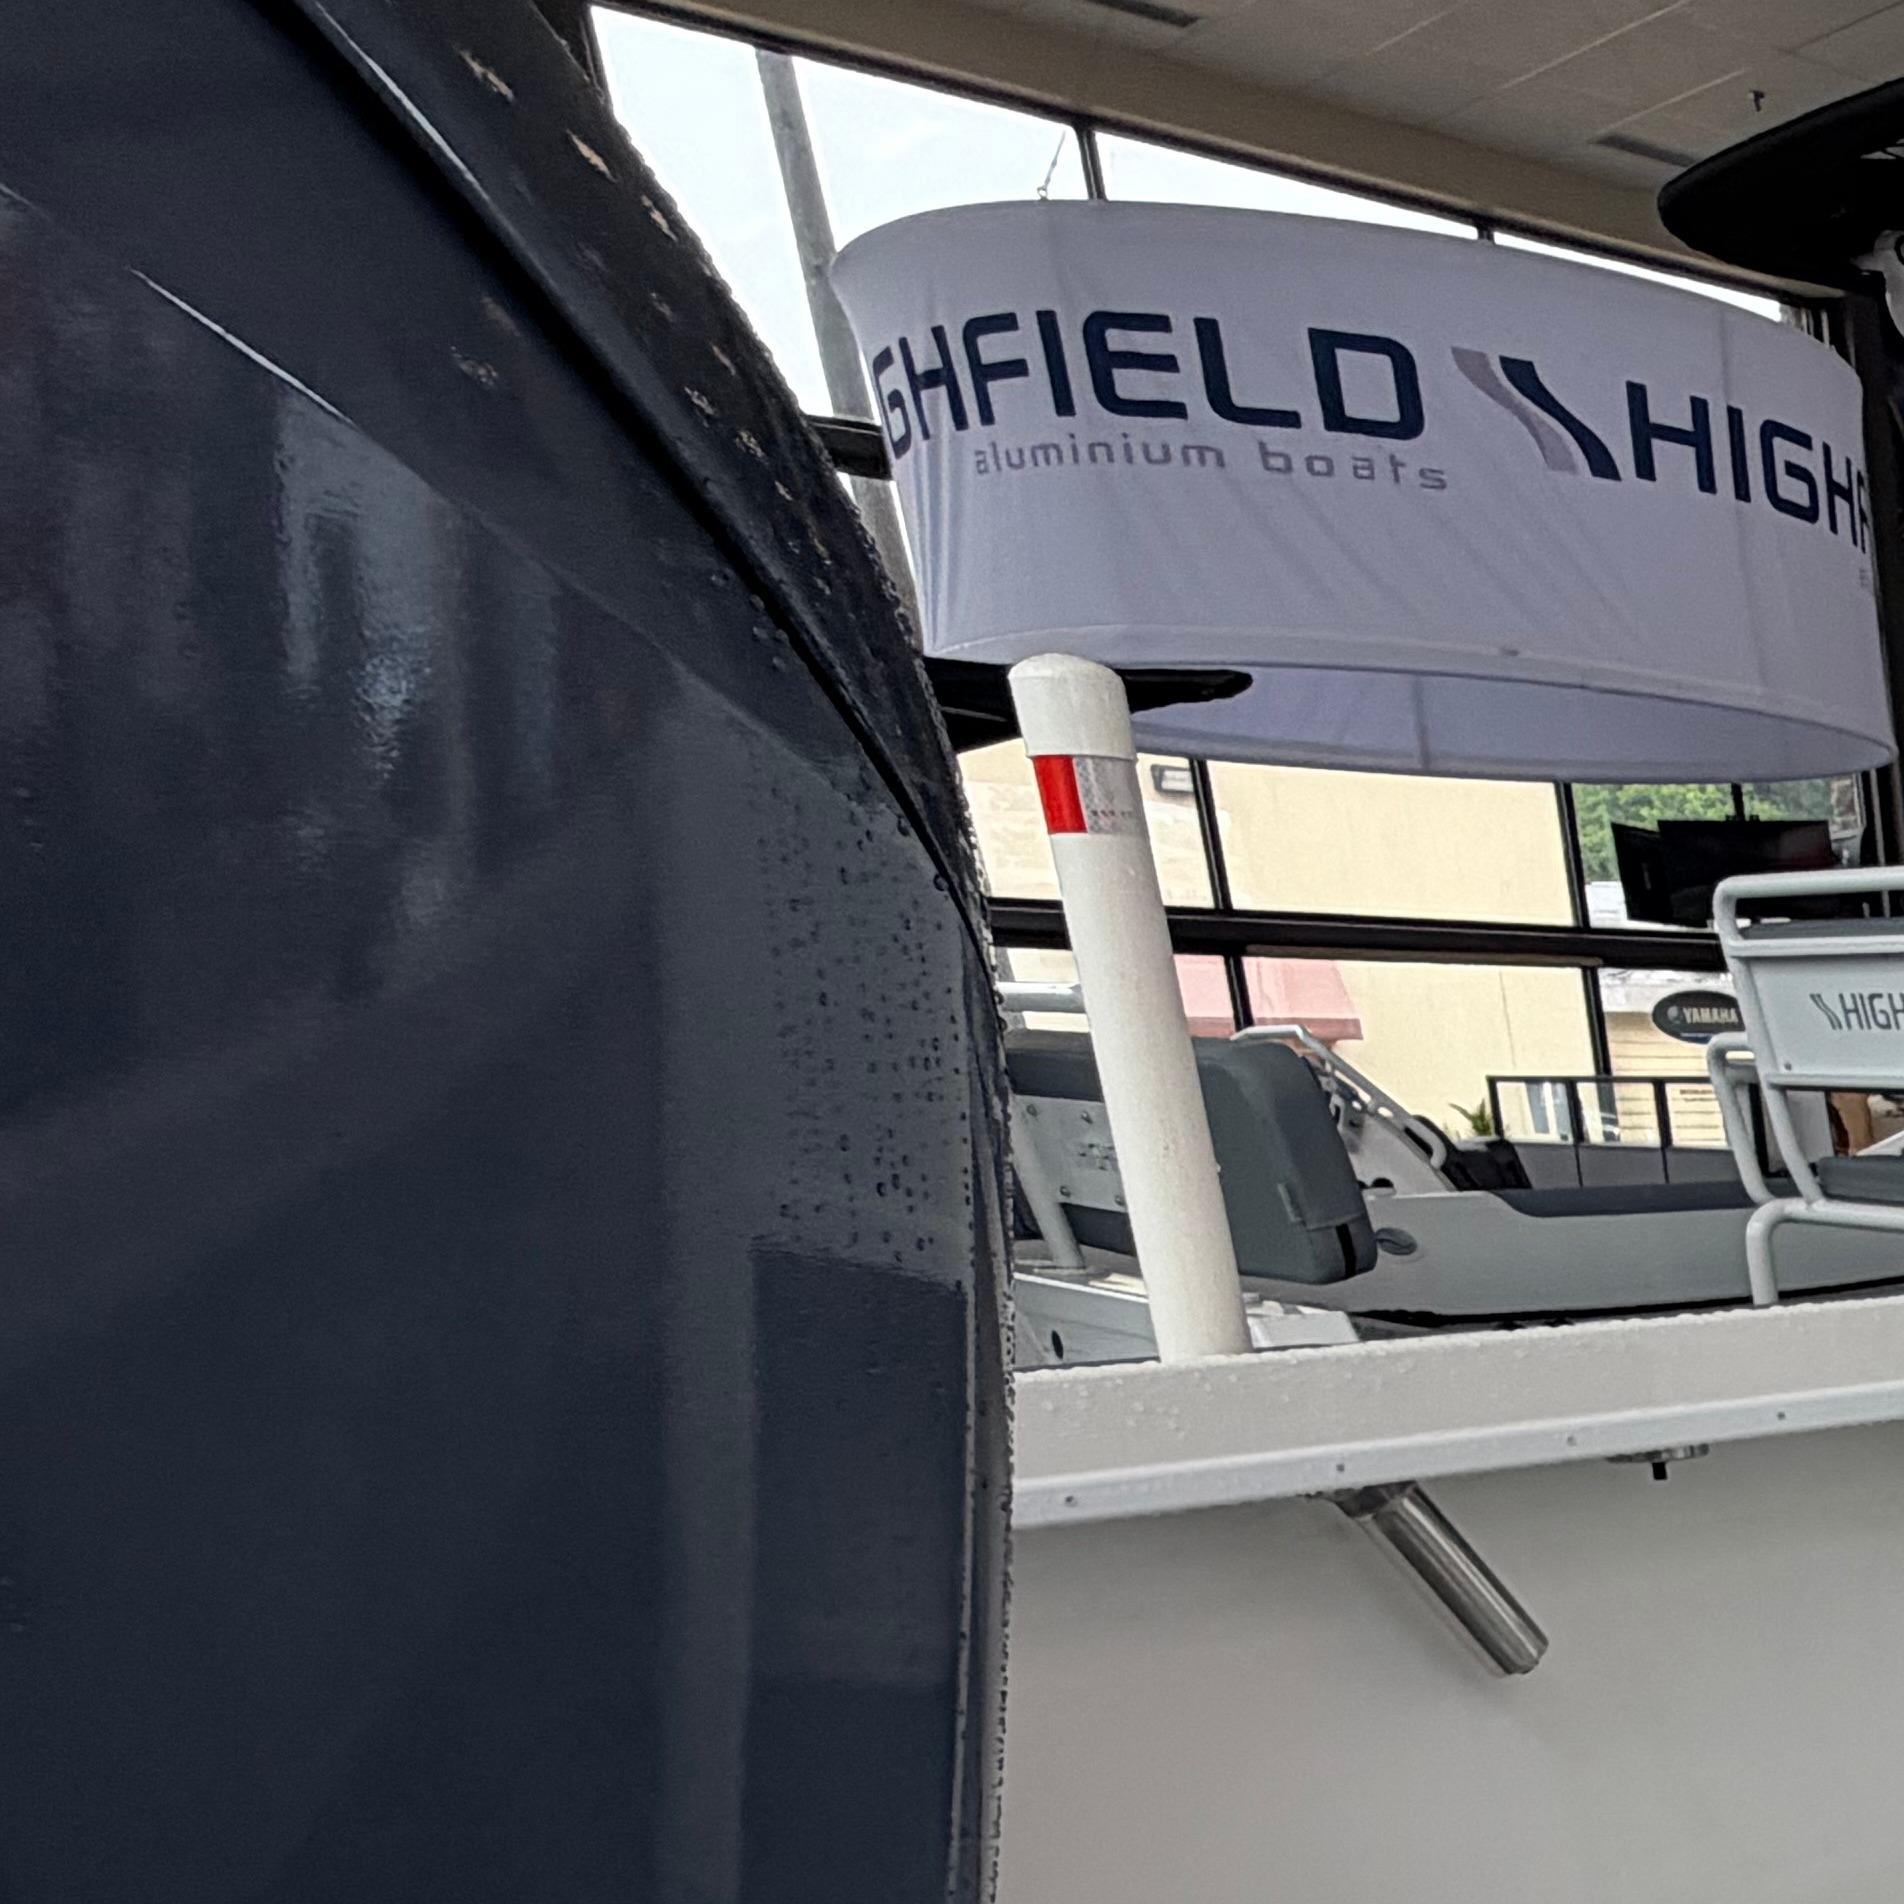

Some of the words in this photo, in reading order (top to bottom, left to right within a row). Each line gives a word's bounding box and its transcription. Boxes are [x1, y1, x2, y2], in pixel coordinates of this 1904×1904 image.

[974, 432, 1226, 476] aluminium
[1257, 440, 1449, 491] boats
[1682, 1006, 1739, 1024] YAMAHA
